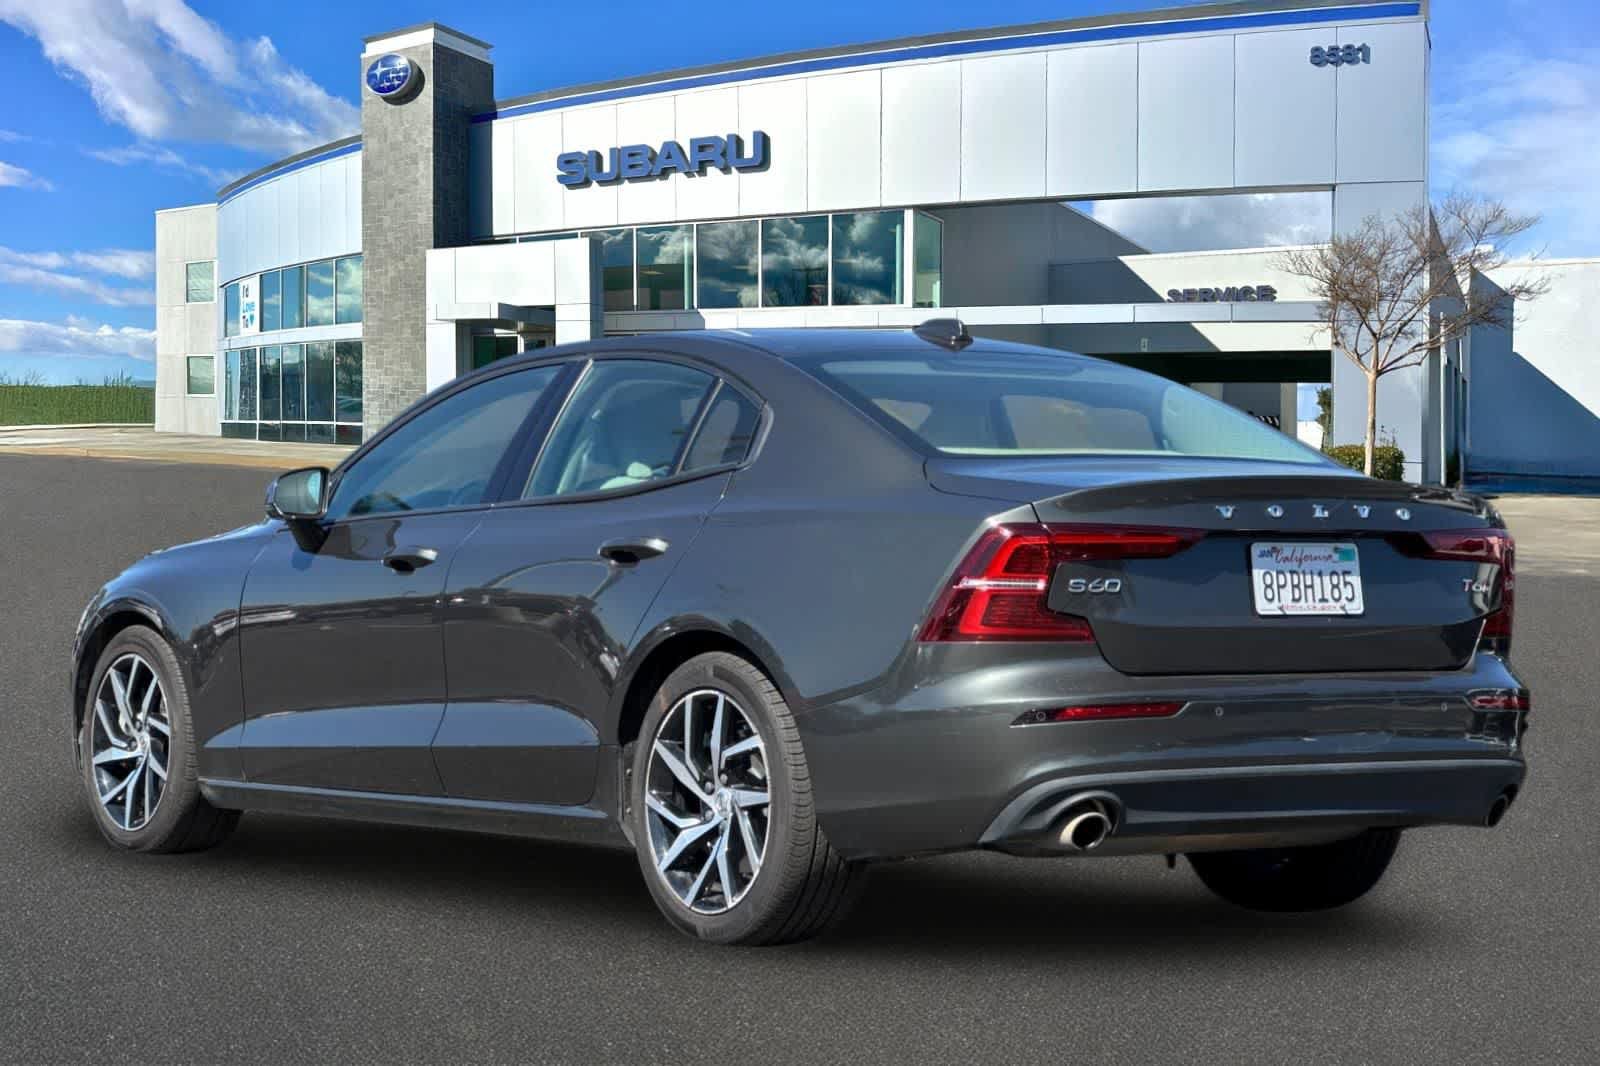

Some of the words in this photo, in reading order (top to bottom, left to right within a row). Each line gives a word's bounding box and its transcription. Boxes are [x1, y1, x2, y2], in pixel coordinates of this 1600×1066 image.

[557, 130, 771, 190] SUBARU
[1167, 284, 1277, 303] SERVICE
[1215, 504, 1411, 521] VOLVO
[1273, 546, 1333, 568] California
[1067, 578, 1121, 593] S60
[1262, 569, 1356, 604] 8PBH185
